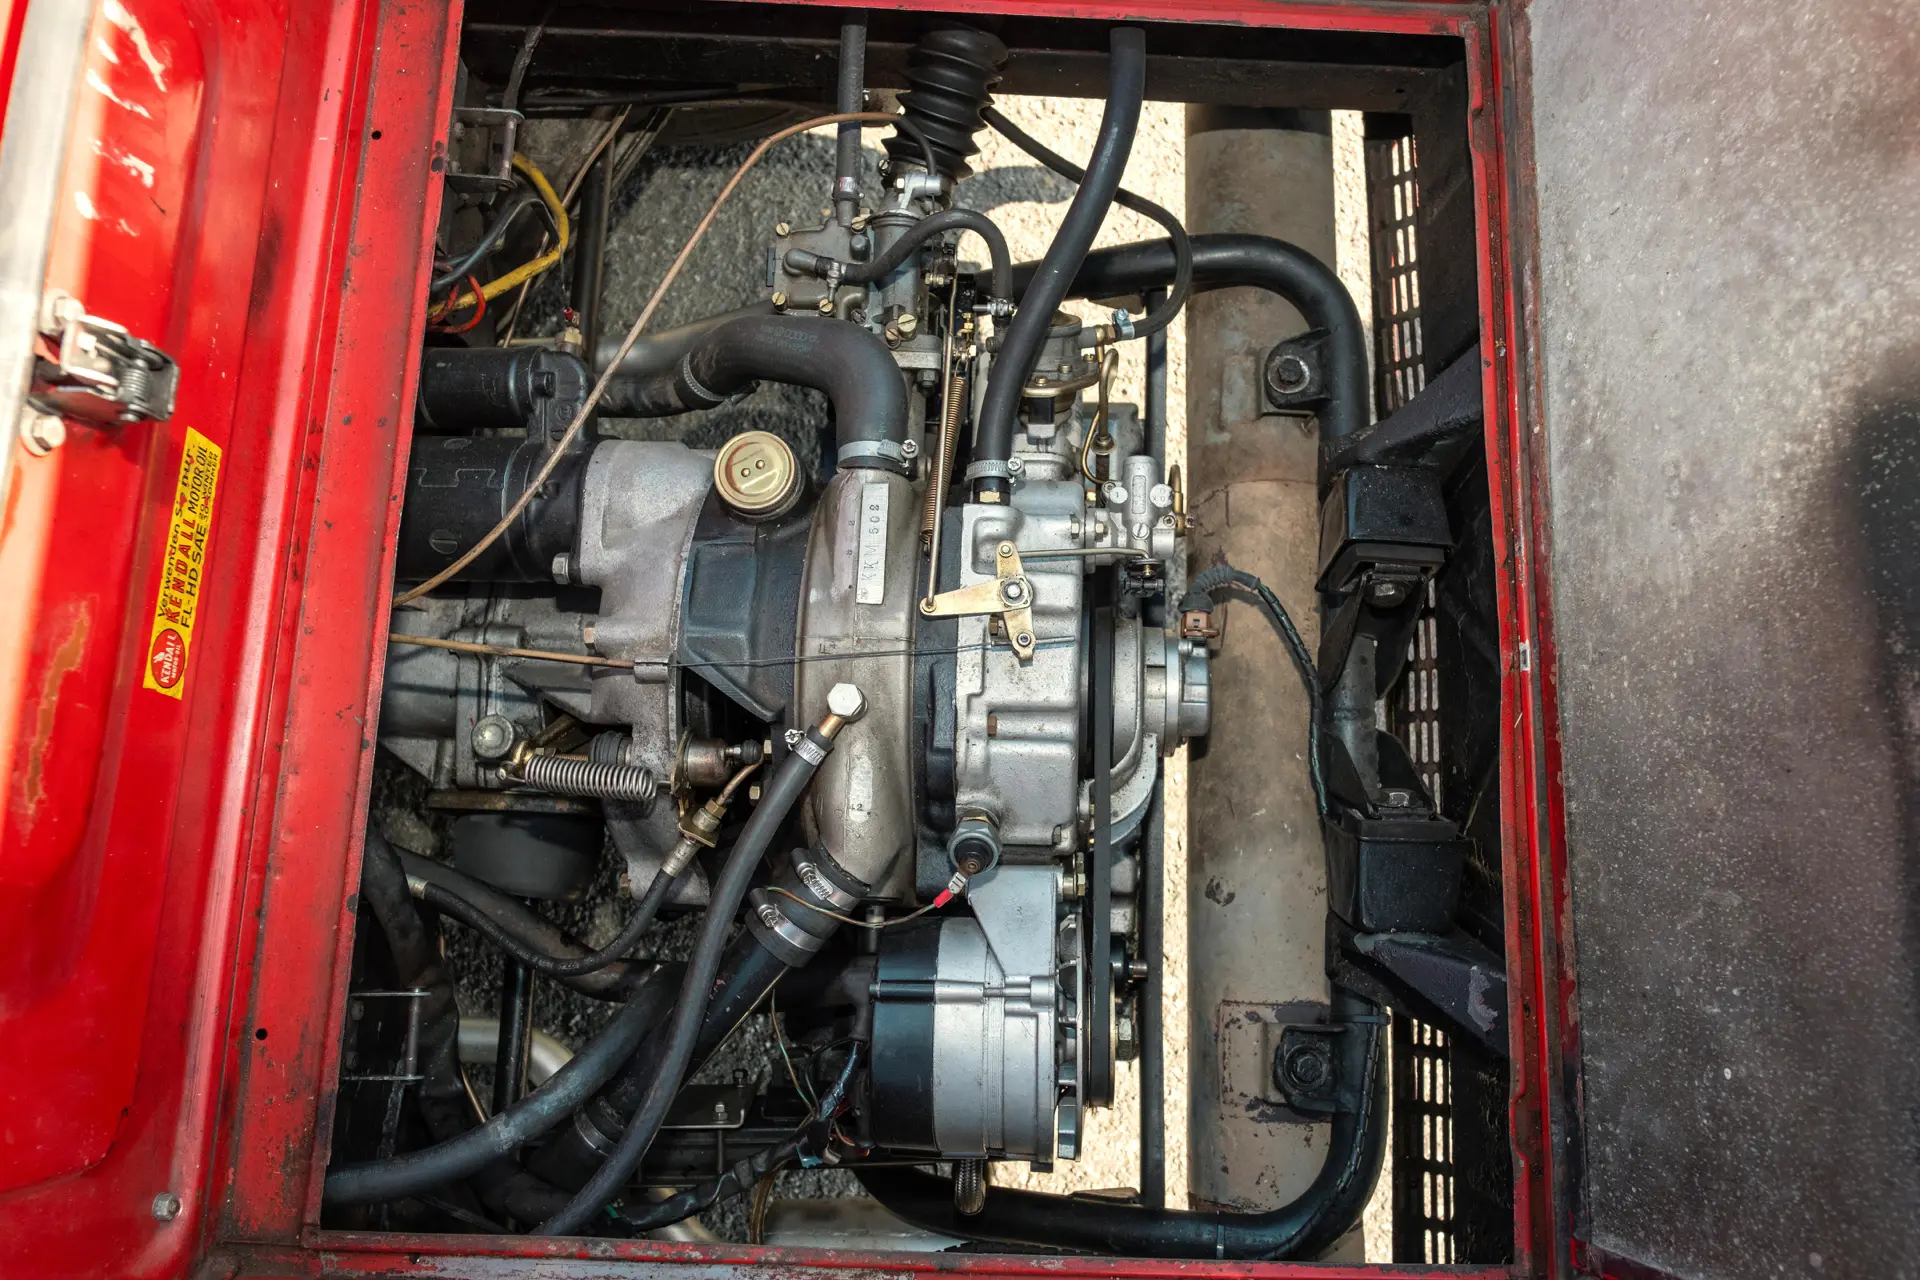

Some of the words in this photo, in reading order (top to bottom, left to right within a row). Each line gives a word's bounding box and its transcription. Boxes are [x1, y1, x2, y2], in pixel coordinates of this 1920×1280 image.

[202, 451, 213, 499] WINTER
[164, 518, 196, 624] KENDALL
[188, 467, 204, 514] MOTOR
[196, 446, 208, 467] OIL
[192, 524, 207, 564] SAE
[868, 504, 881, 535] 502
[158, 523, 180, 617] Verwenden
[160, 634, 176, 684] KENDALL
